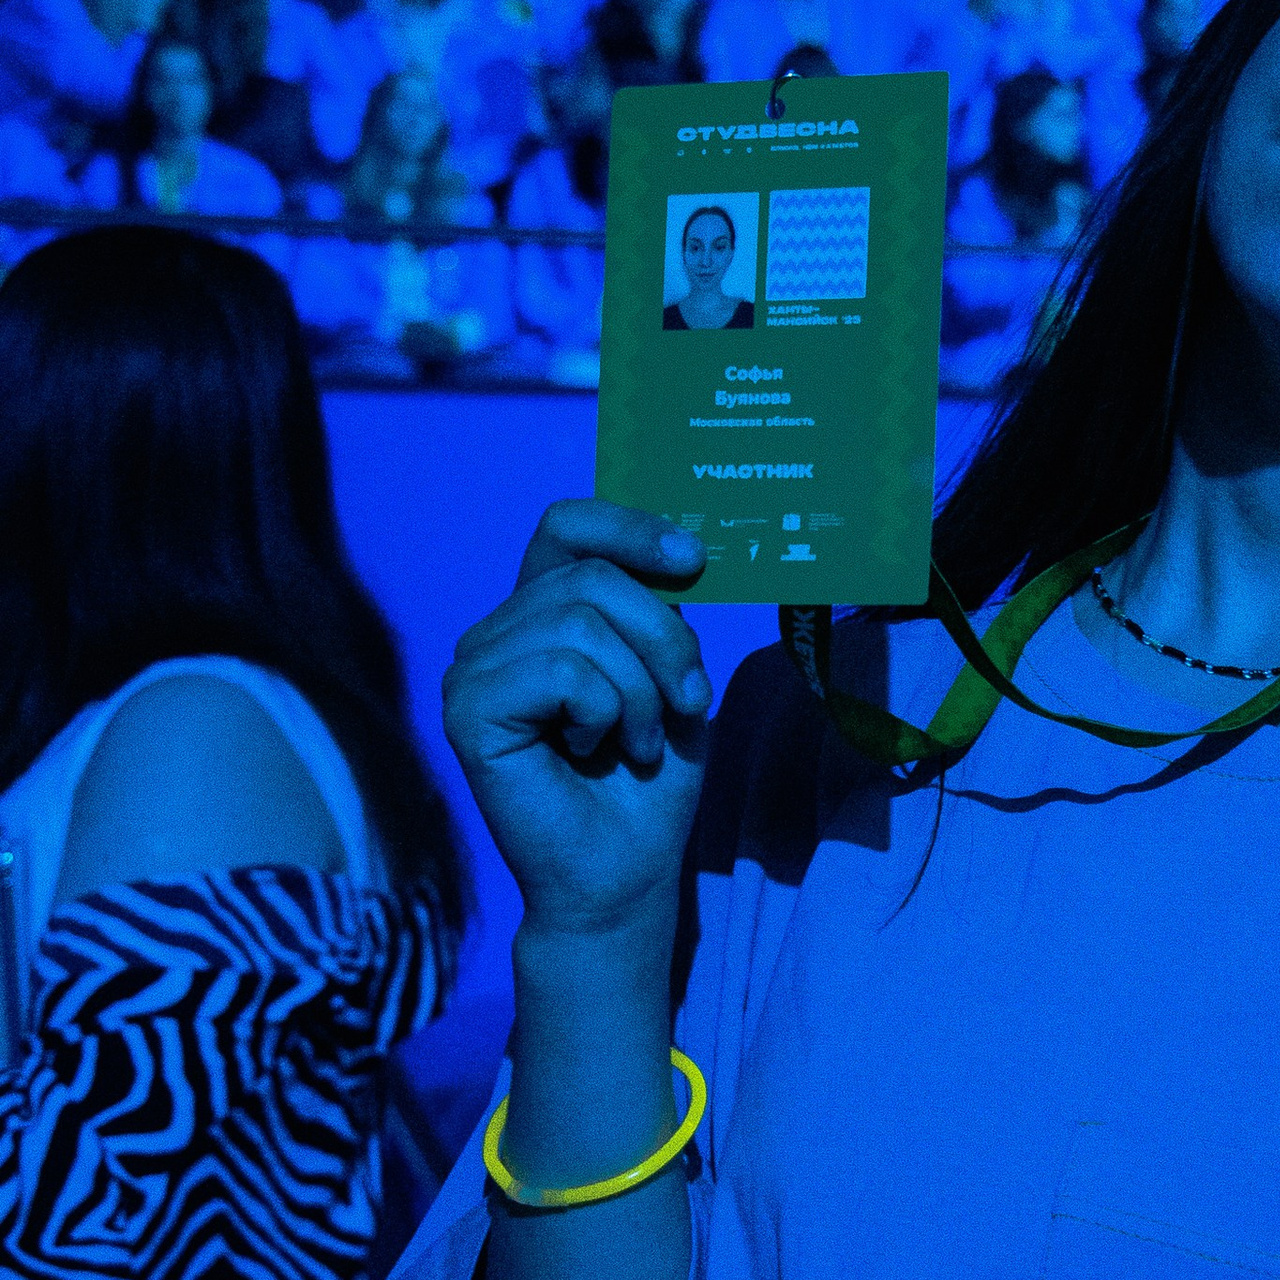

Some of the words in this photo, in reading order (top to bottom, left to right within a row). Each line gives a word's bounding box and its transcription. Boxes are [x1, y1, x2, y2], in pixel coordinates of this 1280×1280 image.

[677, 120, 859, 141] СТУДВЕСНА
[725, 365, 783, 384] Софья
[715, 390, 791, 409] Буянова
[690, 418, 763, 427] Московская
[766, 415, 815, 427] область
[692, 464, 814, 479] УЧАСТНИК
